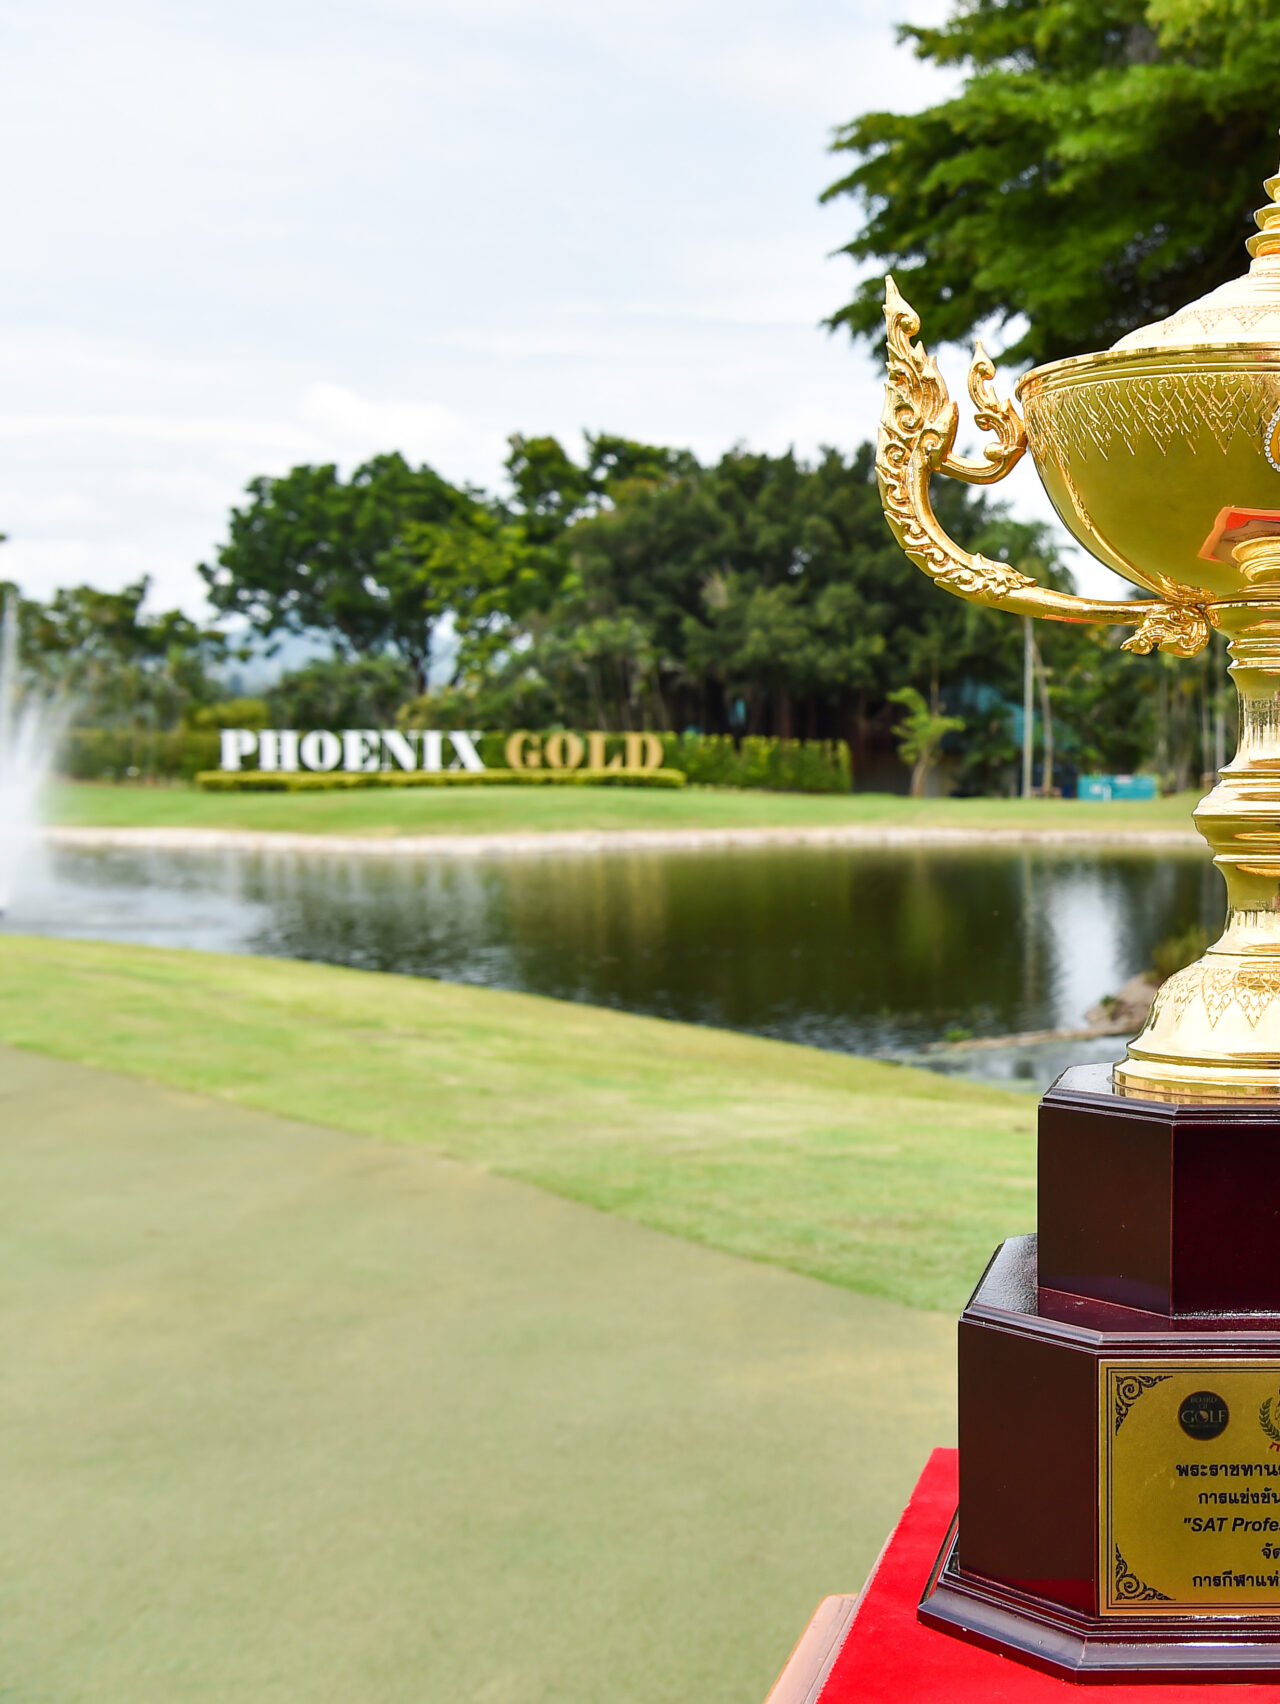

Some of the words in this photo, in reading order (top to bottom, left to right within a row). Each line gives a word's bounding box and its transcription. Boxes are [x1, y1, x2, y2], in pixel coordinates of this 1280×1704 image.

[219, 729, 486, 772] PHOENIX
[504, 730, 665, 770] GOLD
[1181, 1410, 1226, 1423] GOLF
[1183, 1517, 1228, 1532] "SAT
